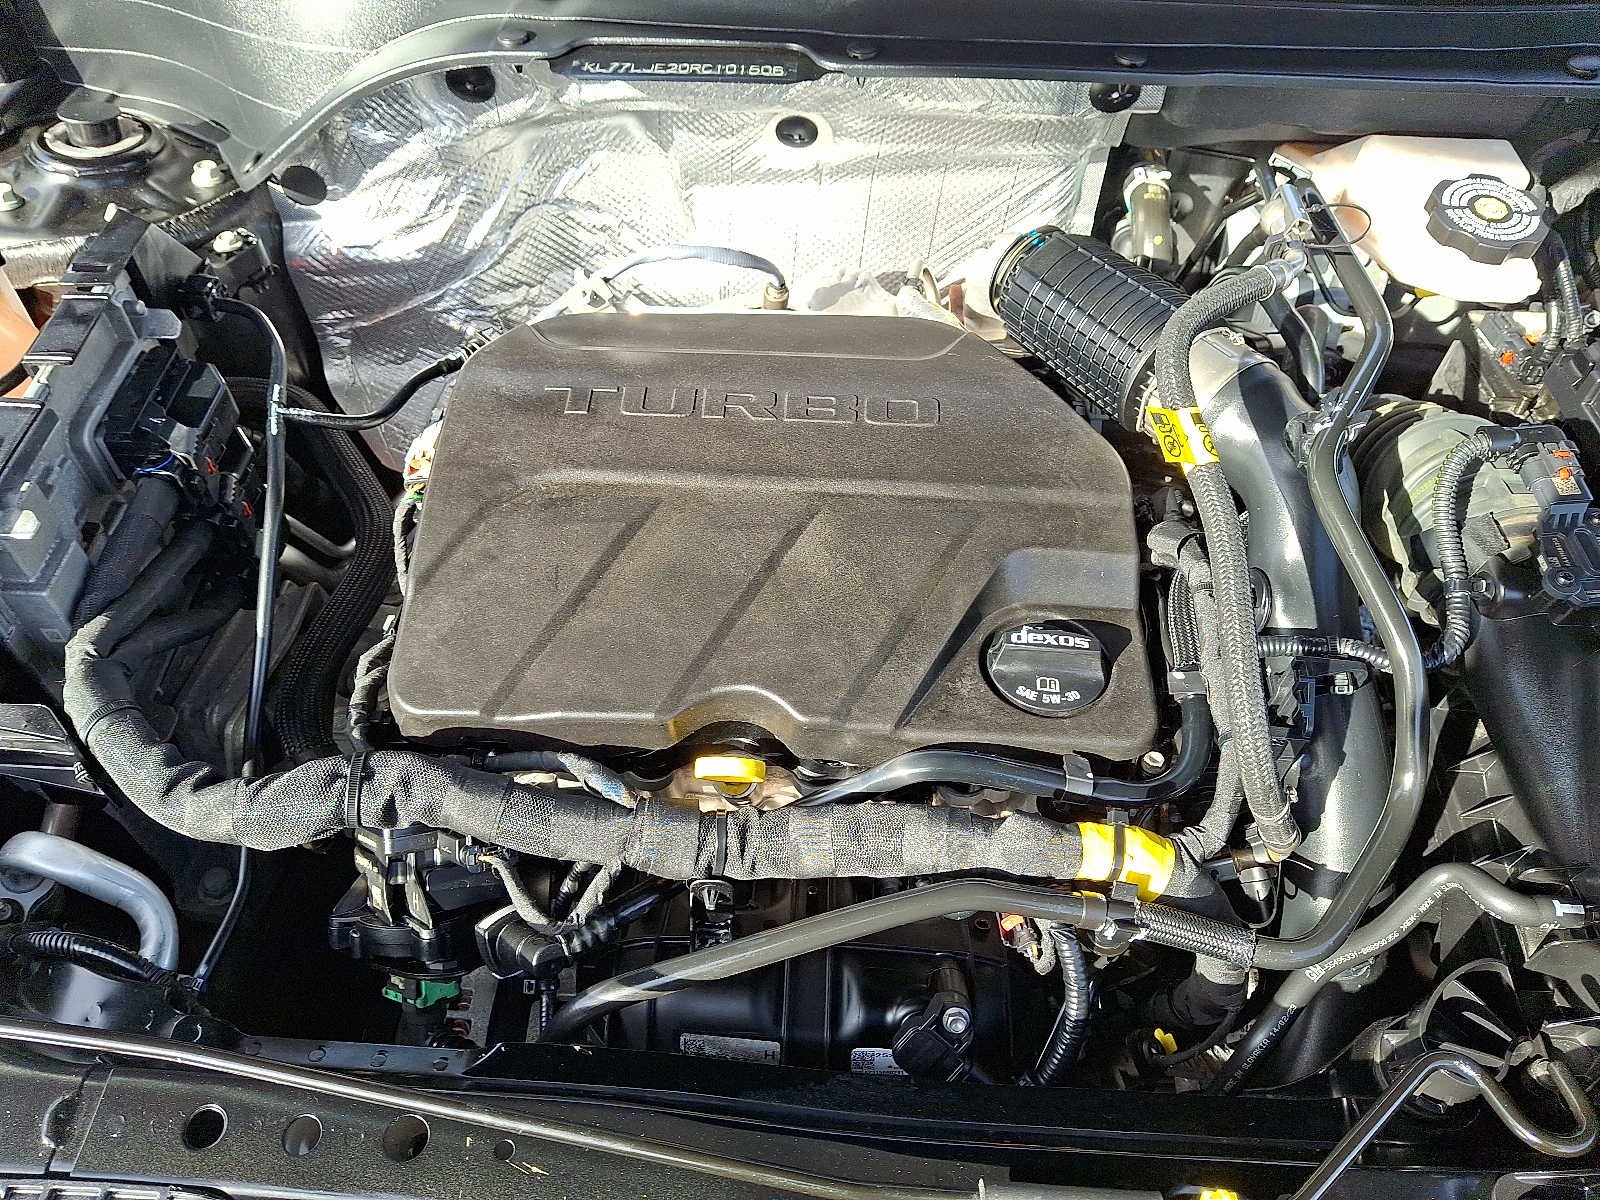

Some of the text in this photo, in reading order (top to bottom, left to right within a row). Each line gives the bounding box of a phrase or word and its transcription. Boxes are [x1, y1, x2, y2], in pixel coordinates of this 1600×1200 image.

[544, 386, 941, 427] TURBO
[1010, 629, 1092, 649] dexos
[1015, 686, 1081, 704] SAE 5W-30
[1304, 963, 1326, 982] GM
[1241, 1038, 1271, 1070] SLOVAKIA
